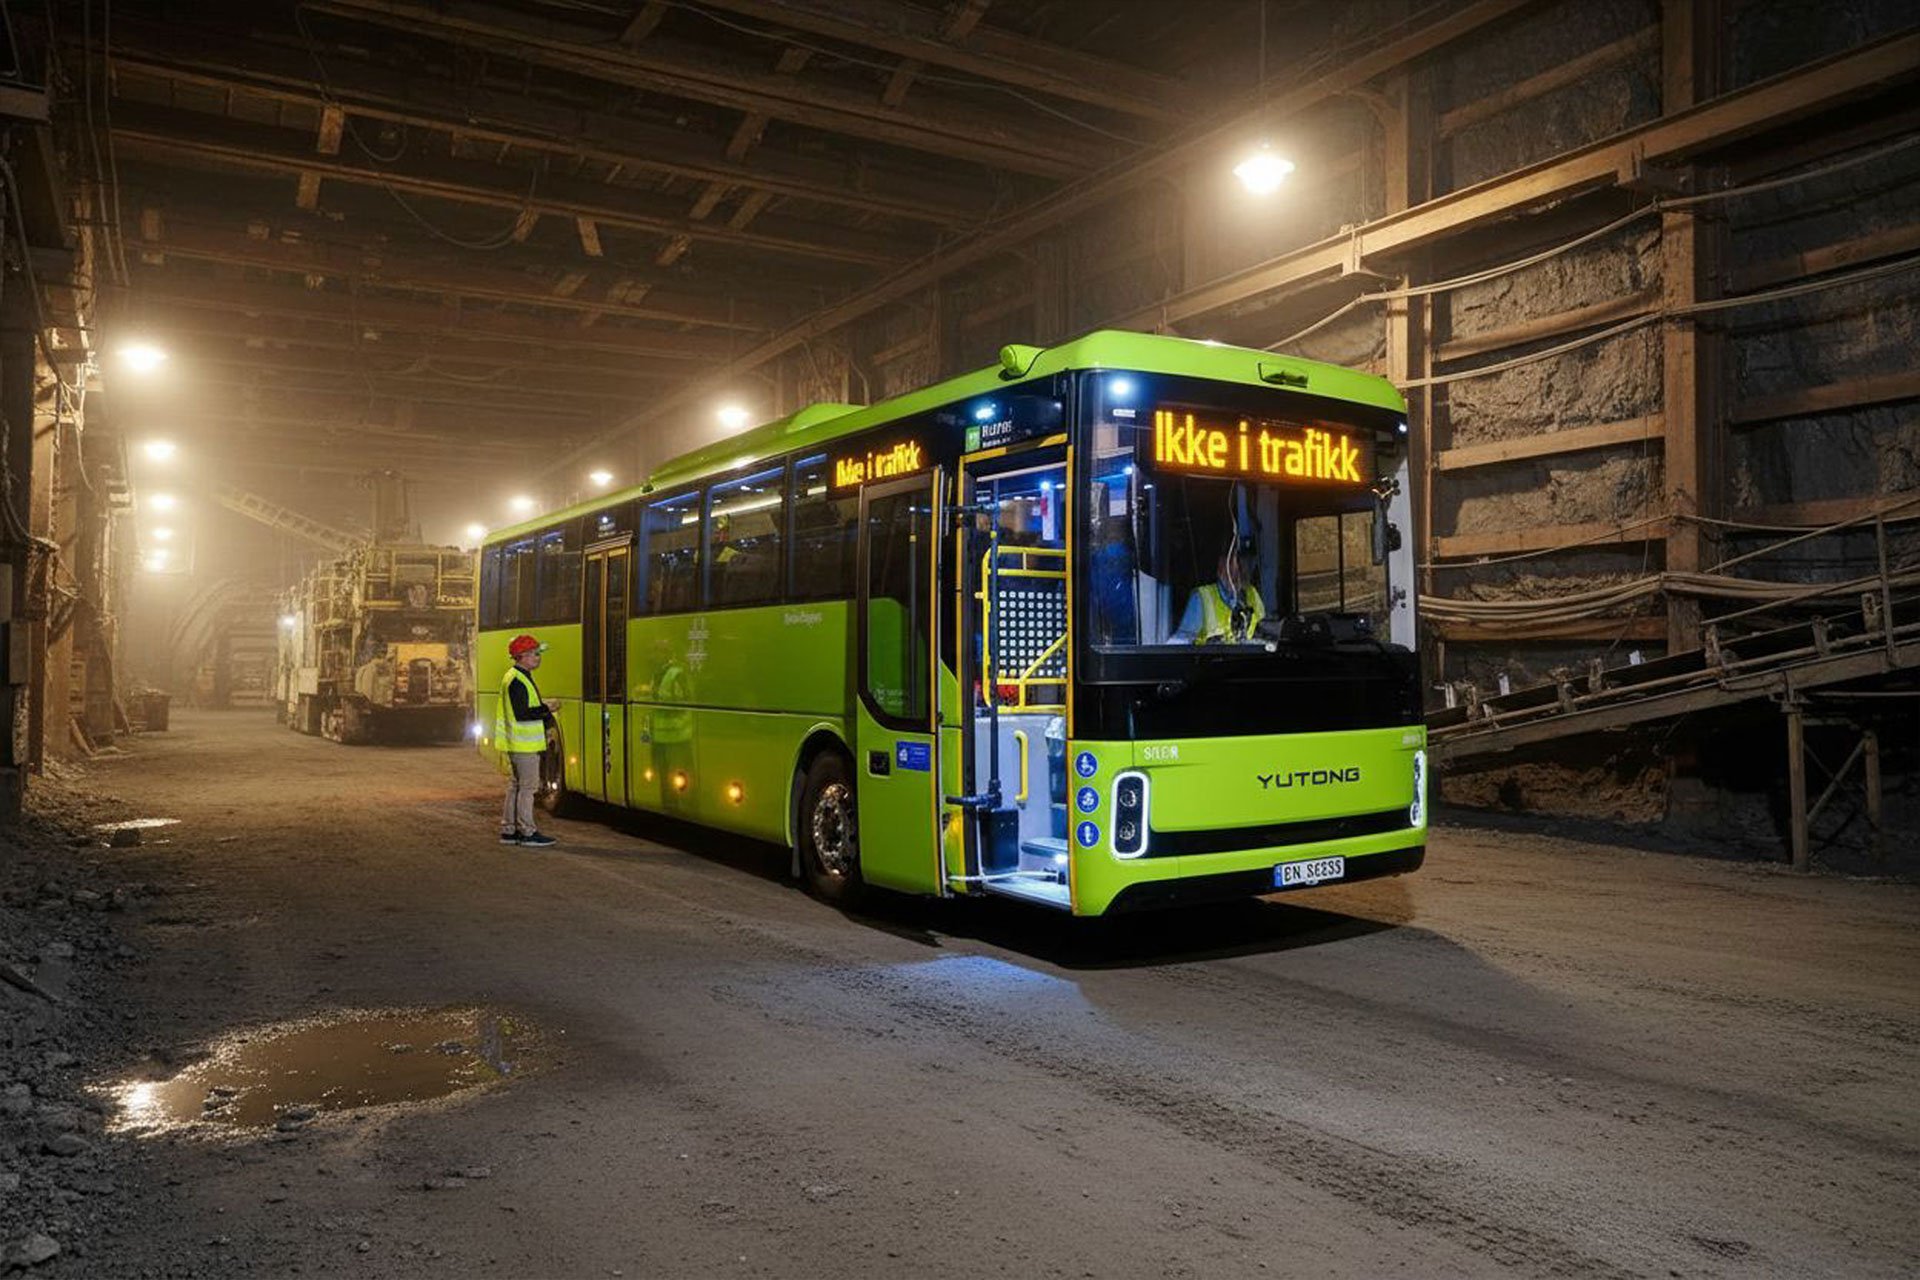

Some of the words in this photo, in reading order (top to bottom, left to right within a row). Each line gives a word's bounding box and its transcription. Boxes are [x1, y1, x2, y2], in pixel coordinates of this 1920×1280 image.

[1155, 410, 1228, 468] Ikke
[1239, 421, 1249, 472] i
[1259, 428, 1361, 483] trafikk
[867, 451, 873, 481] i
[1256, 766, 1360, 790] YUTONG
